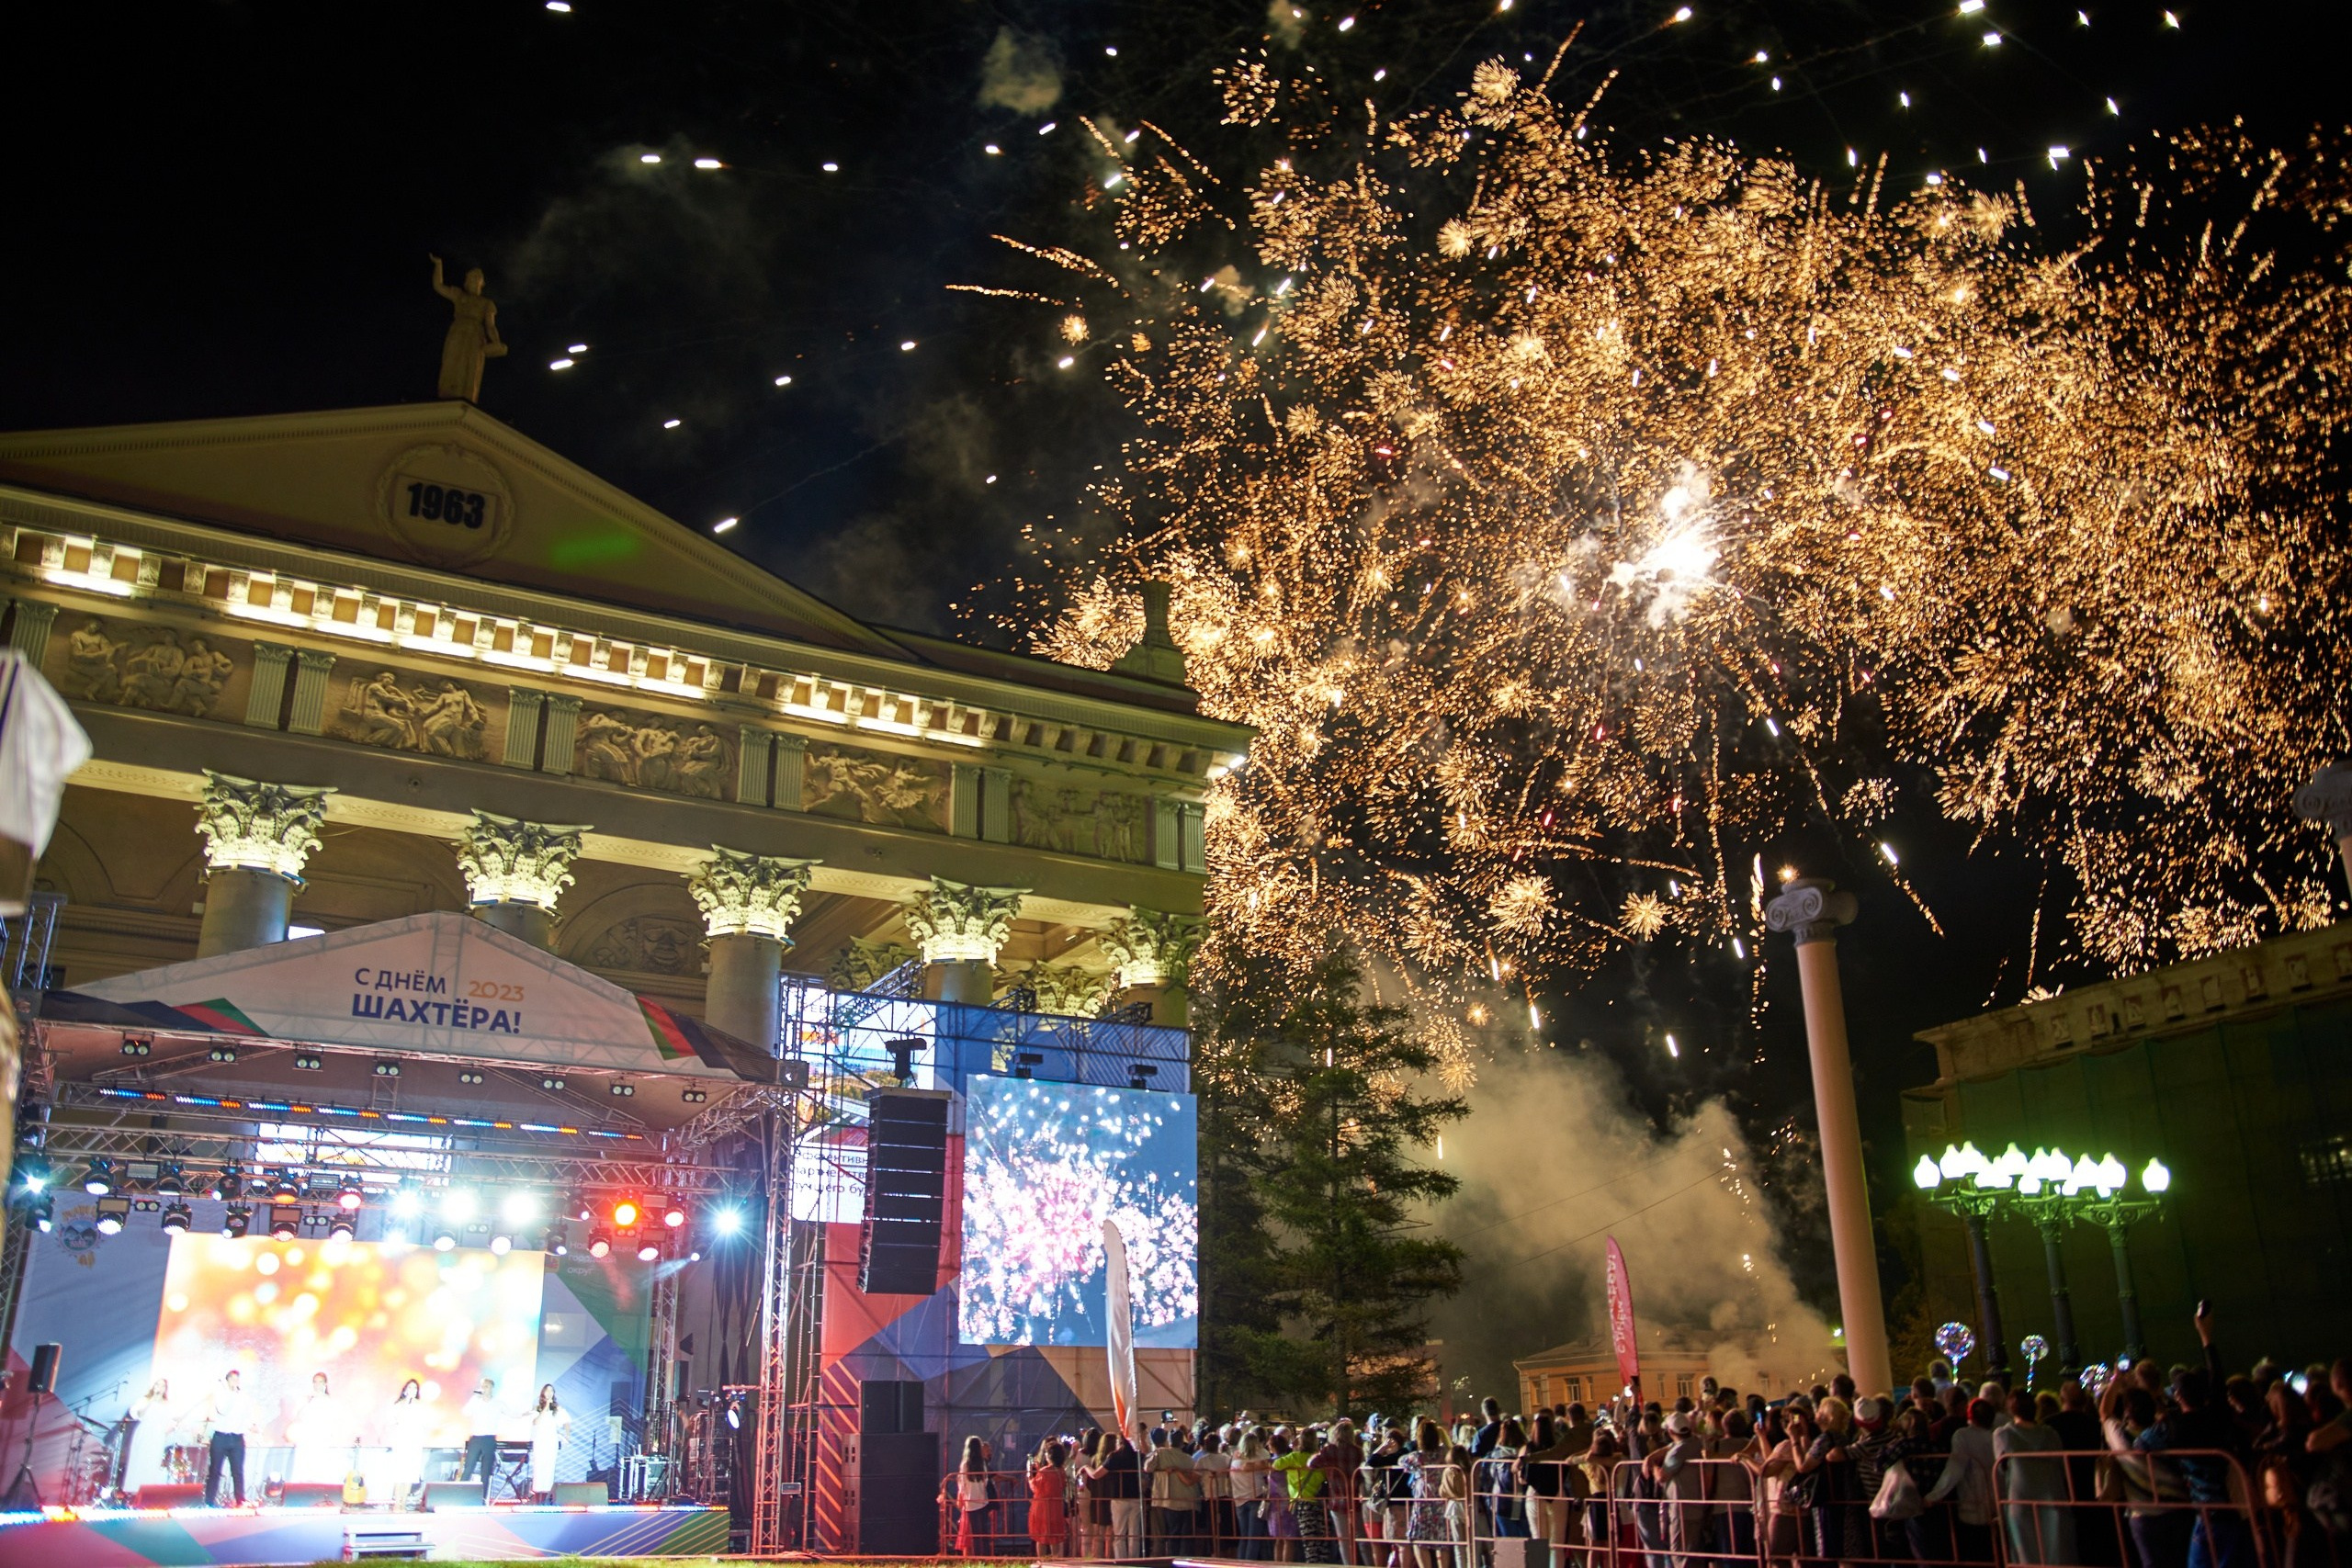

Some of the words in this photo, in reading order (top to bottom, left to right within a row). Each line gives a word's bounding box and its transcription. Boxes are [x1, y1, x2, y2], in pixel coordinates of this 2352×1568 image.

[407, 482, 485, 529] 1963
[355, 968, 370, 985] С
[375, 970, 447, 994] ДНЁМ
[469, 980, 525, 1002] 2023
[352, 994, 522, 1034] ШАХТЁРА!
